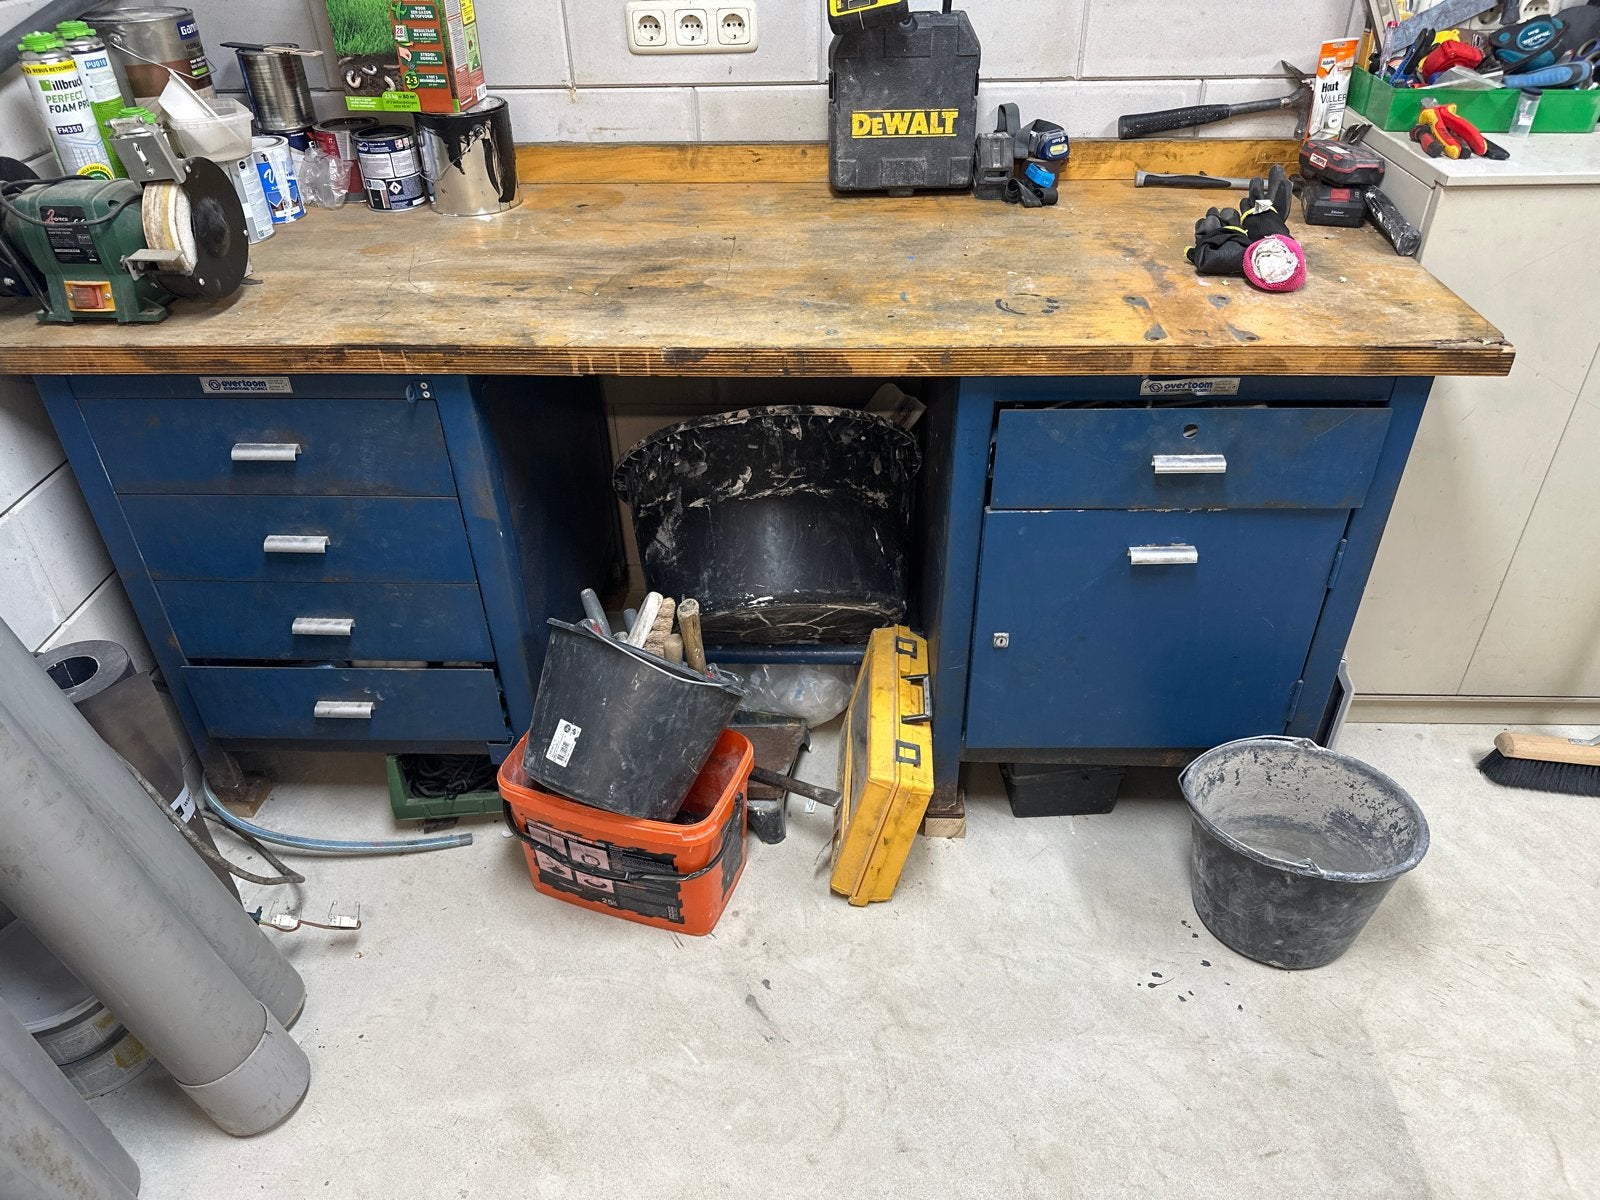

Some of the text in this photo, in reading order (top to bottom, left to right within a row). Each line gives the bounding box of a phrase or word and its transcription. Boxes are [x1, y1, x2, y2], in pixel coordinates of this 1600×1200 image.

[45, 90, 84, 104] PERFECT
[49, 102, 77, 114] FOAM
[58, 125, 82, 135] FM350
[1163, 381, 1213, 389] overtoom
